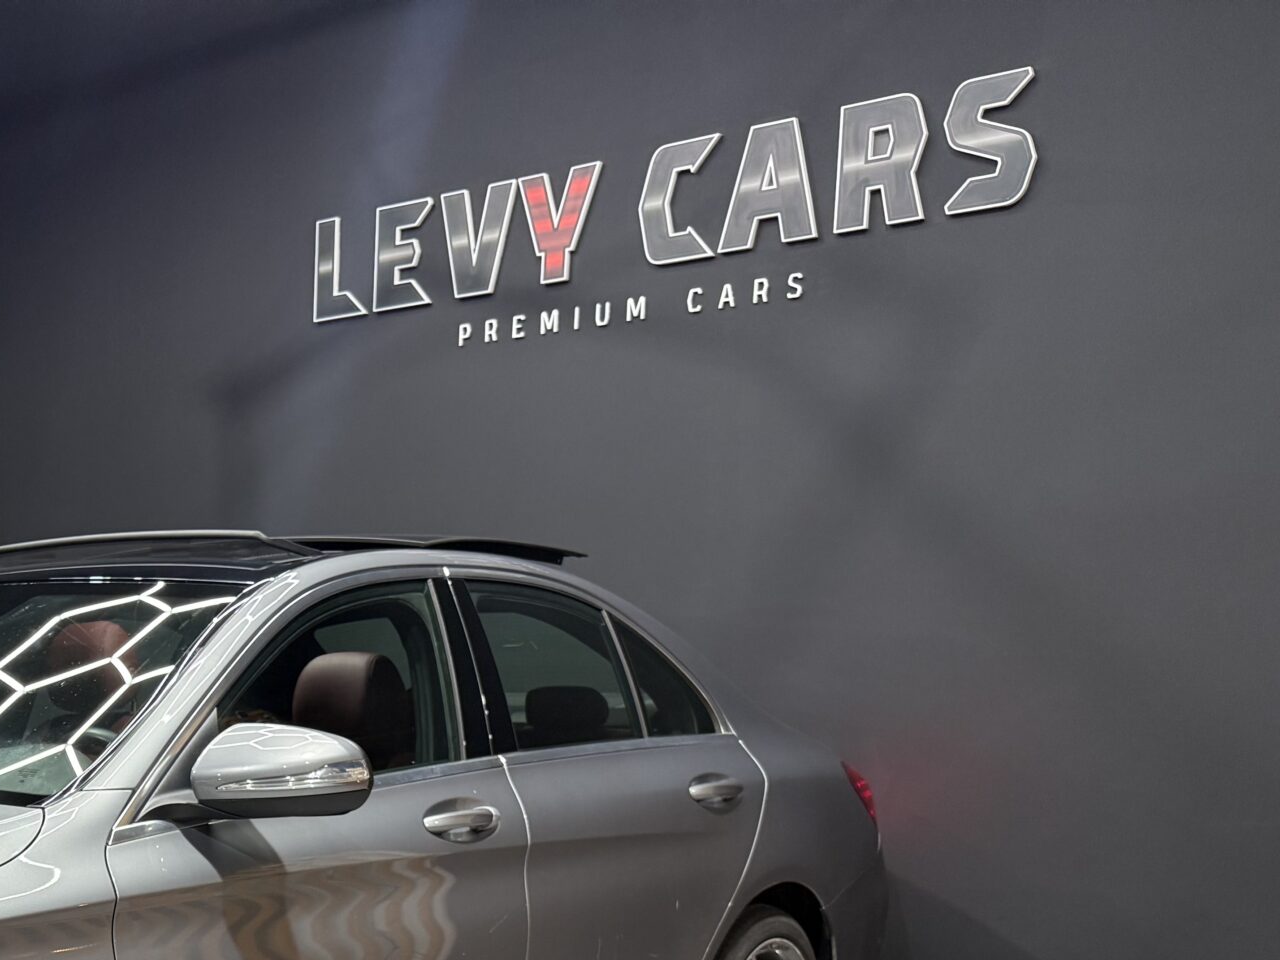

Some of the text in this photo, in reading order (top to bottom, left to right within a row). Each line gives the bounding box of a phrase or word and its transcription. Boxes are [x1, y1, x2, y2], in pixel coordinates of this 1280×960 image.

[313, 66, 1038, 323] LEVY CARS
[457, 272, 805, 348] PREMIUM CARS
